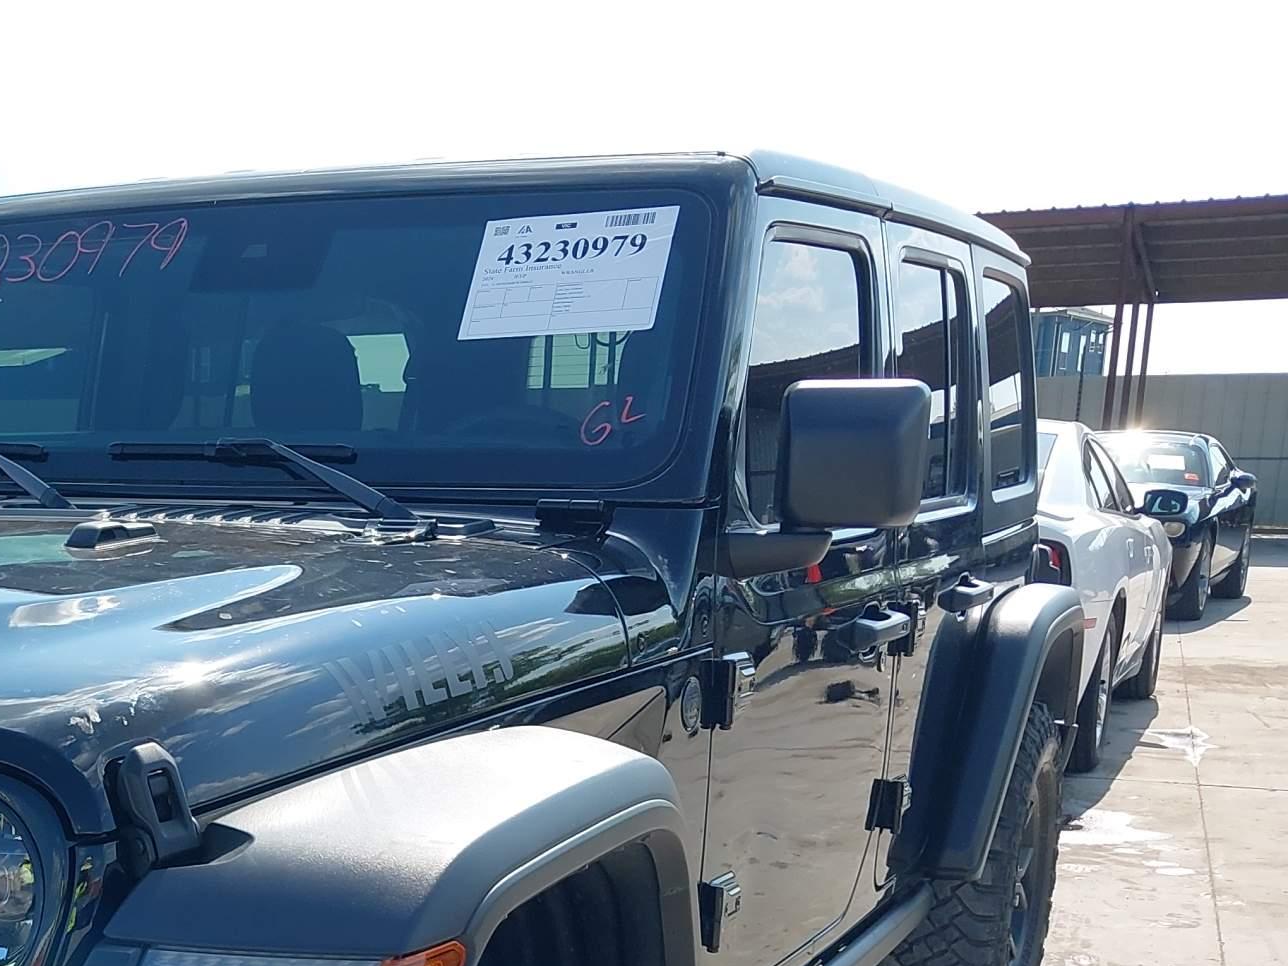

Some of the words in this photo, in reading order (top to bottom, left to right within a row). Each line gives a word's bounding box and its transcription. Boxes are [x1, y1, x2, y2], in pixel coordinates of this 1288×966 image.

[497, 233, 648, 266] 43230979
[504, 266, 523, 274] Farm
[525, 264, 562, 272] Insurance
